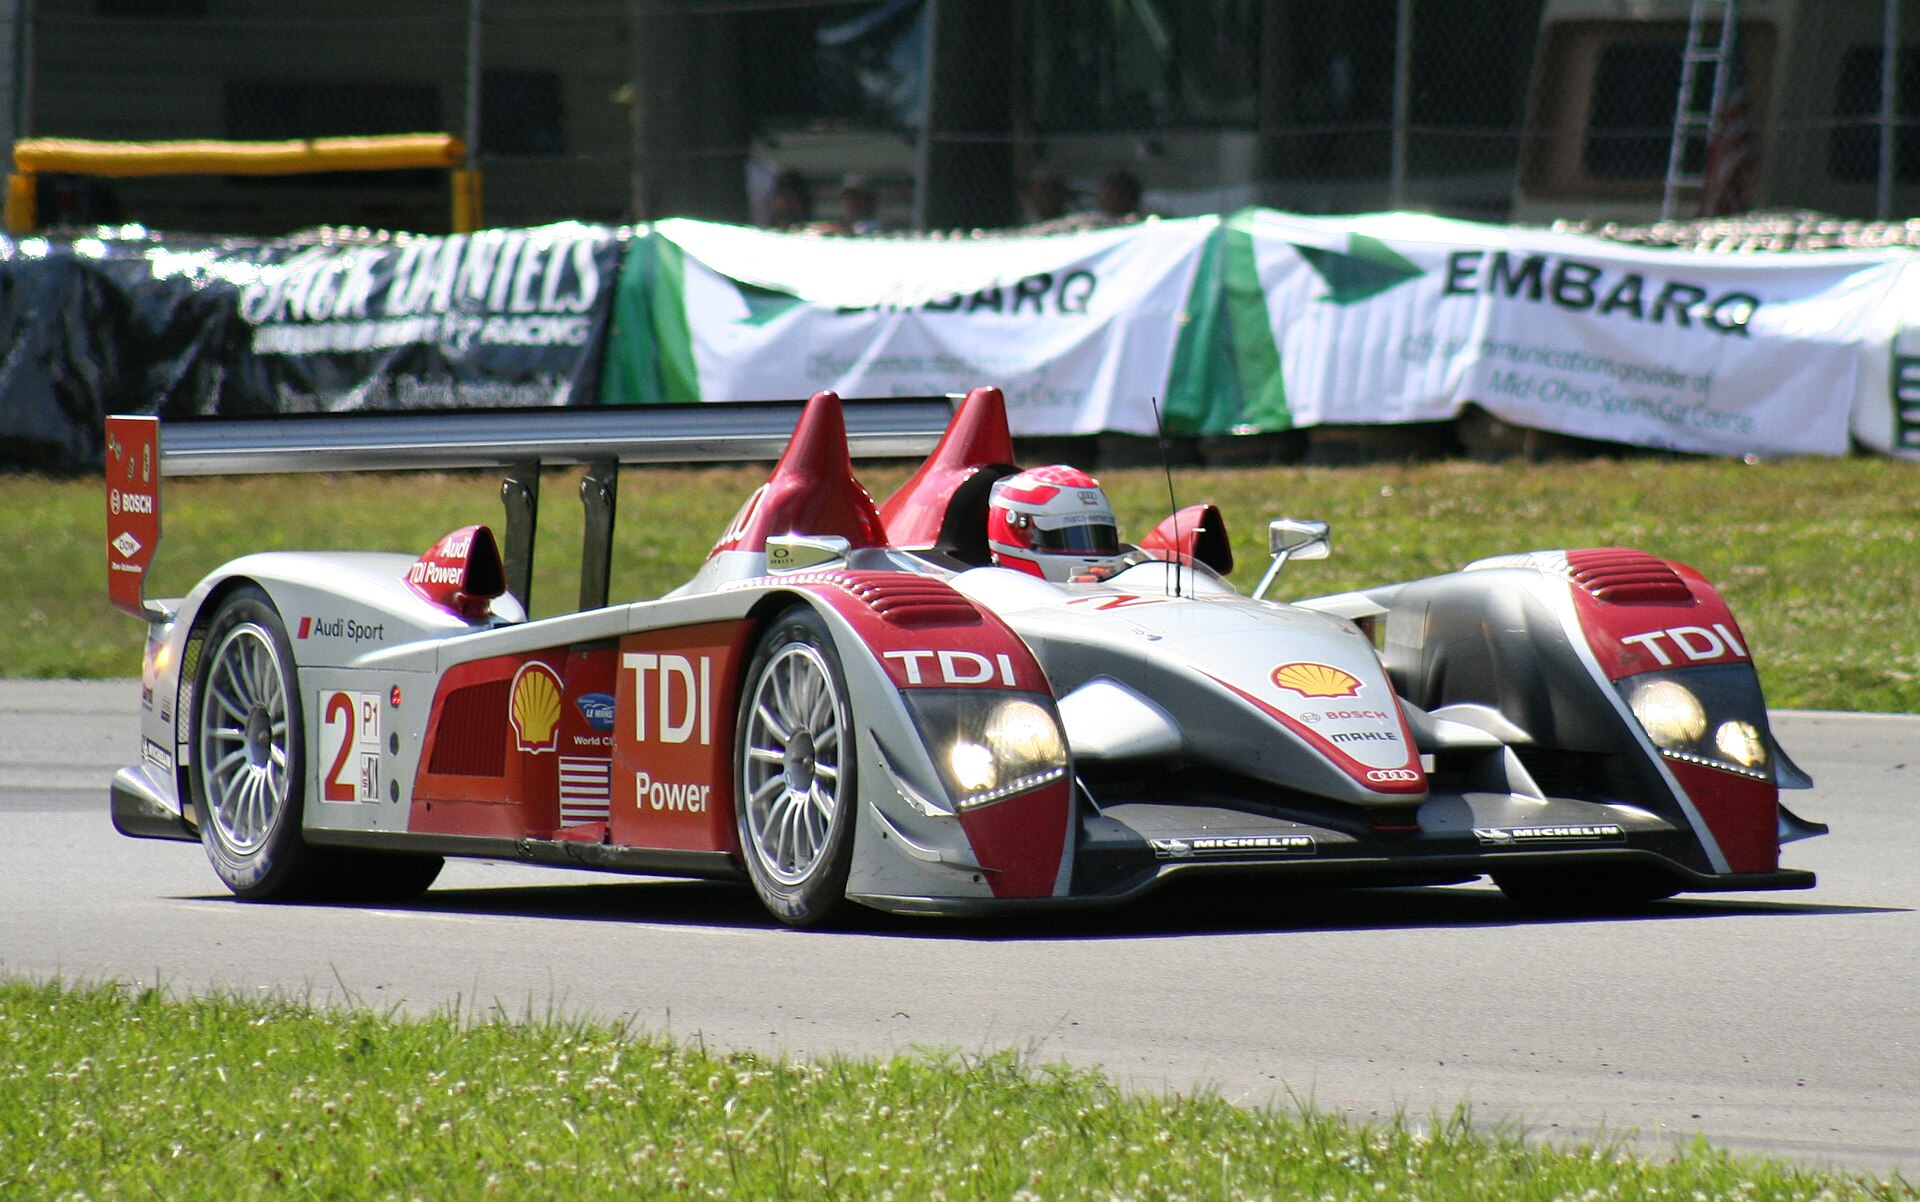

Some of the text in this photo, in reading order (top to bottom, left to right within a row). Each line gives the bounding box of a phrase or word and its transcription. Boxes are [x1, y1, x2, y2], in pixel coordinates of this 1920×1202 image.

[1442, 251, 1762, 338] EMBARQ
[123, 494, 152, 514] BOSCH
[441, 536, 471, 559] Audi
[409, 562, 463, 584] TDI Power
[314, 619, 384, 643] Audi Sport
[1620, 623, 1747, 666] TDI
[883, 650, 1016, 687] TDI
[623, 652, 711, 745] TDI
[362, 701, 378, 737] P1
[1325, 711, 1388, 720] BOSCH
[325, 692, 355, 801] 2
[573, 735, 601, 746] World
[1330, 732, 1397, 743] MAHLE
[636, 771, 710, 813] Power
[1193, 837, 1309, 848] MICHELIN
[1512, 826, 1619, 837] MICHELIN
